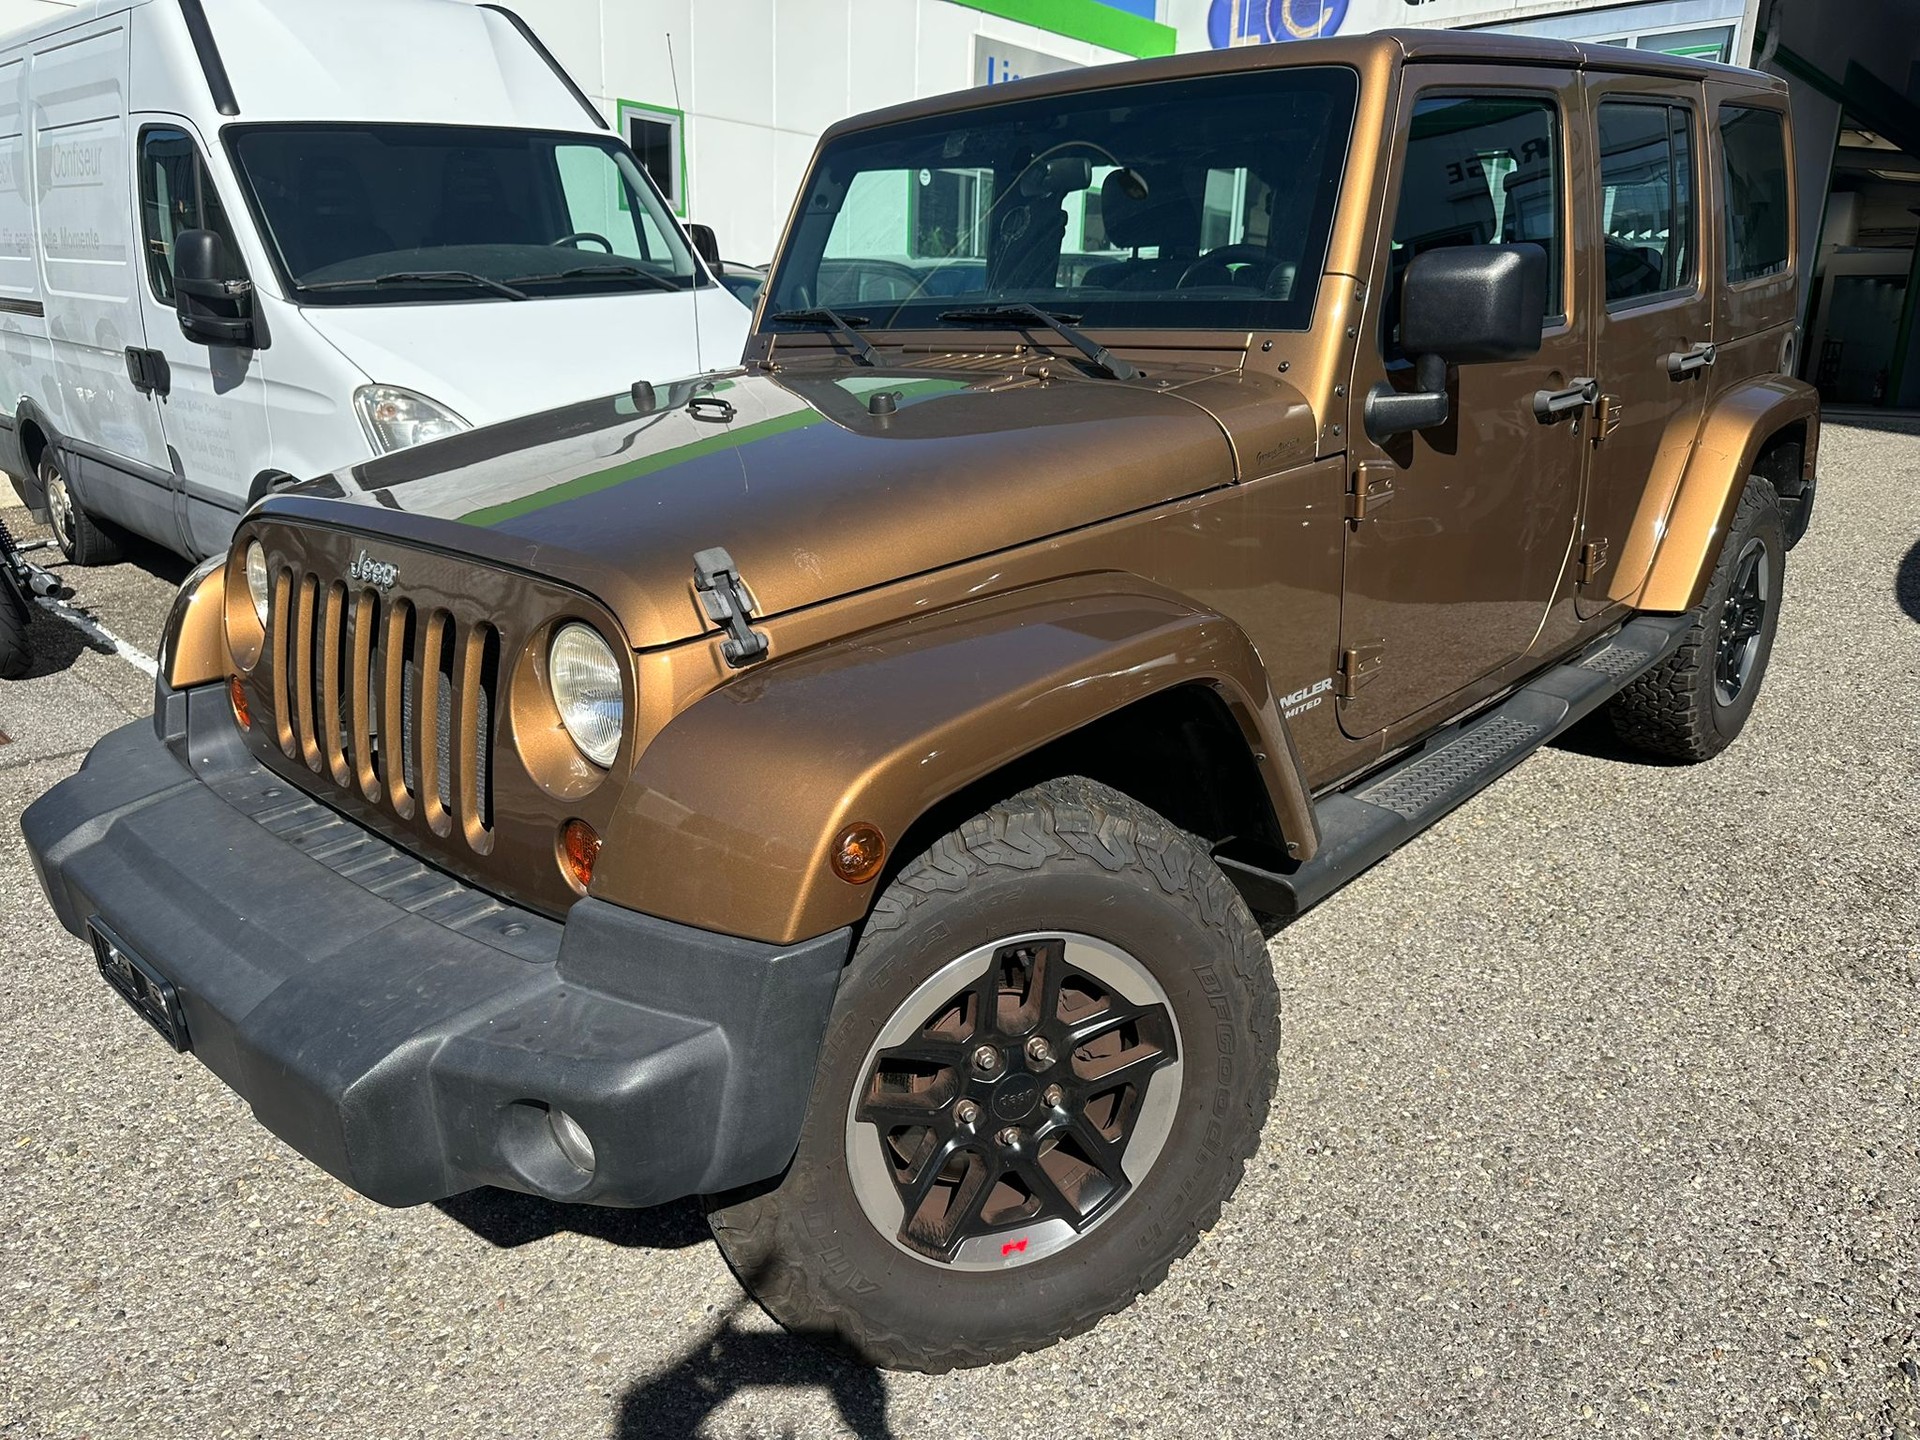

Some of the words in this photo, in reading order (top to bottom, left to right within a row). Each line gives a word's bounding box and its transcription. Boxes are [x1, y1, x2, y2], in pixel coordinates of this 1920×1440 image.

[53, 141, 103, 178] Confiseur
[60, 226, 100, 250] Momente
[350, 549, 399, 593] Jeep
[1279, 677, 1333, 709] NGLER
[1284, 697, 1322, 719] MITED
